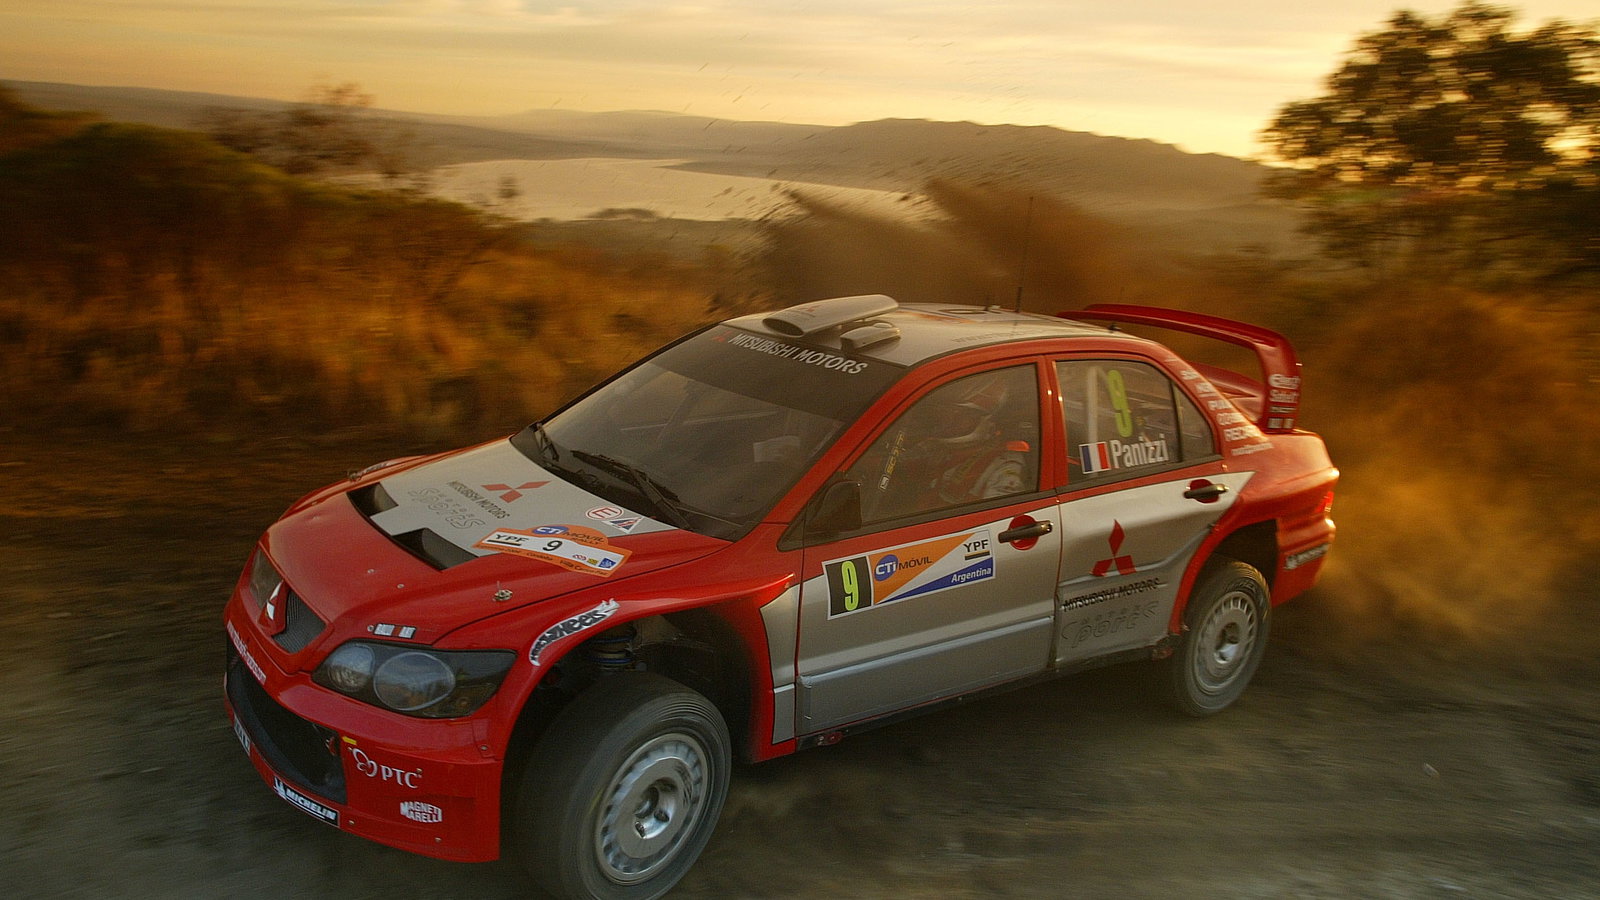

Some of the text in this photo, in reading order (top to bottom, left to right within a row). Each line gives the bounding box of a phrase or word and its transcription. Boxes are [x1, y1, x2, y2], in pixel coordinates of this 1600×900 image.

[728, 333, 868, 374] MITSUBISHI MOTORS
[1107, 370, 1133, 437] 9
[1110, 433, 1169, 469] Panizzi
[495, 534, 563, 552] YPF 9
[963, 539, 989, 553] YPF
[898, 556, 933, 571] MÓVIL
[951, 566, 992, 583] Argentina
[841, 560, 860, 611] 9
[381, 765, 418, 789] PTC
[285, 789, 337, 821] MICHELIN
